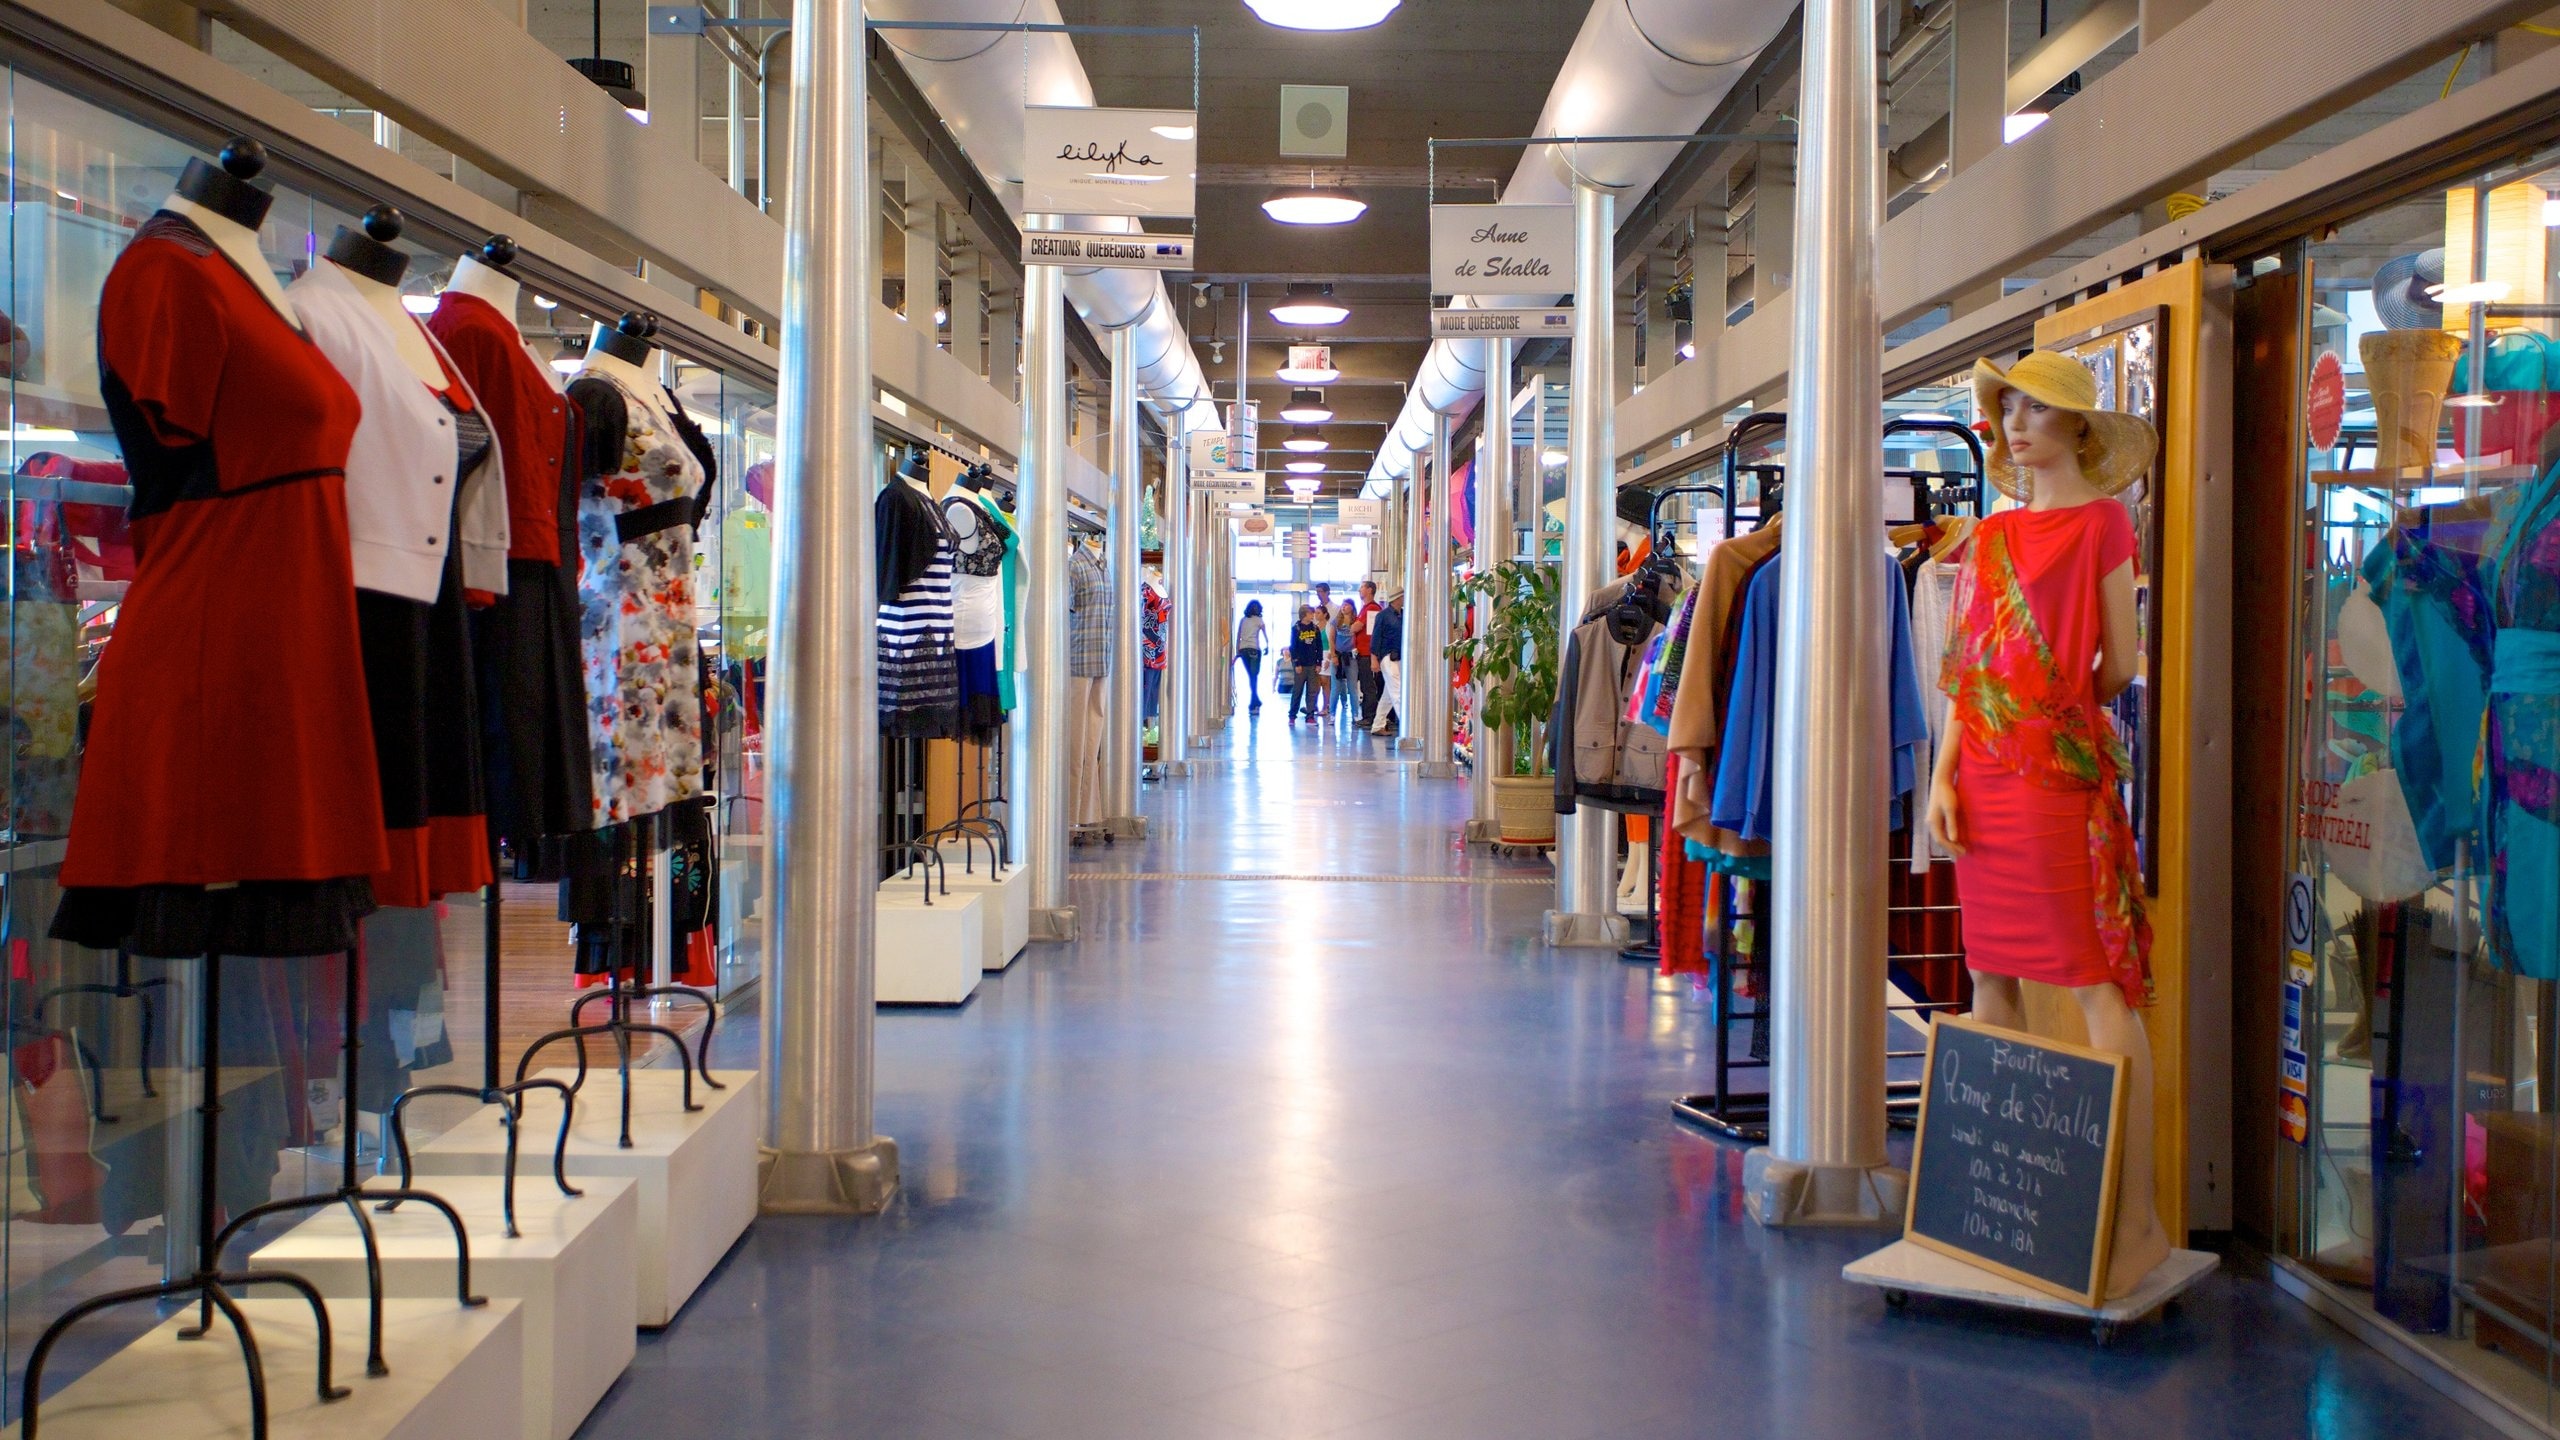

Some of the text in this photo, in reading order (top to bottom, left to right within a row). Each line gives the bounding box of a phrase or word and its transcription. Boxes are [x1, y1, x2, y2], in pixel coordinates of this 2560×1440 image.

[1031, 236, 1146, 259] CRÉATIONS QUÉBÉCOISES
[1471, 222, 1528, 243] Anne
[1455, 256, 1552, 277] de Shalla
[1440, 314, 1520, 331] MODE QUÉBÉCOISE
[1984, 1038, 2070, 1089] Boutique
[2287, 1060, 2303, 1081] VISA
[2000, 1082, 2025, 1123] de
[2031, 1093, 2102, 1148] Shalla
[1992, 1140, 2009, 1157] au
[2016, 1146, 2067, 1176] samedi
[1969, 1156, 2042, 1197] 10h à 21h
[1973, 1186, 2038, 1227] Dimanche
[1962, 1209, 1991, 1239] 10h
[2011, 1228, 2034, 1255] 18h
